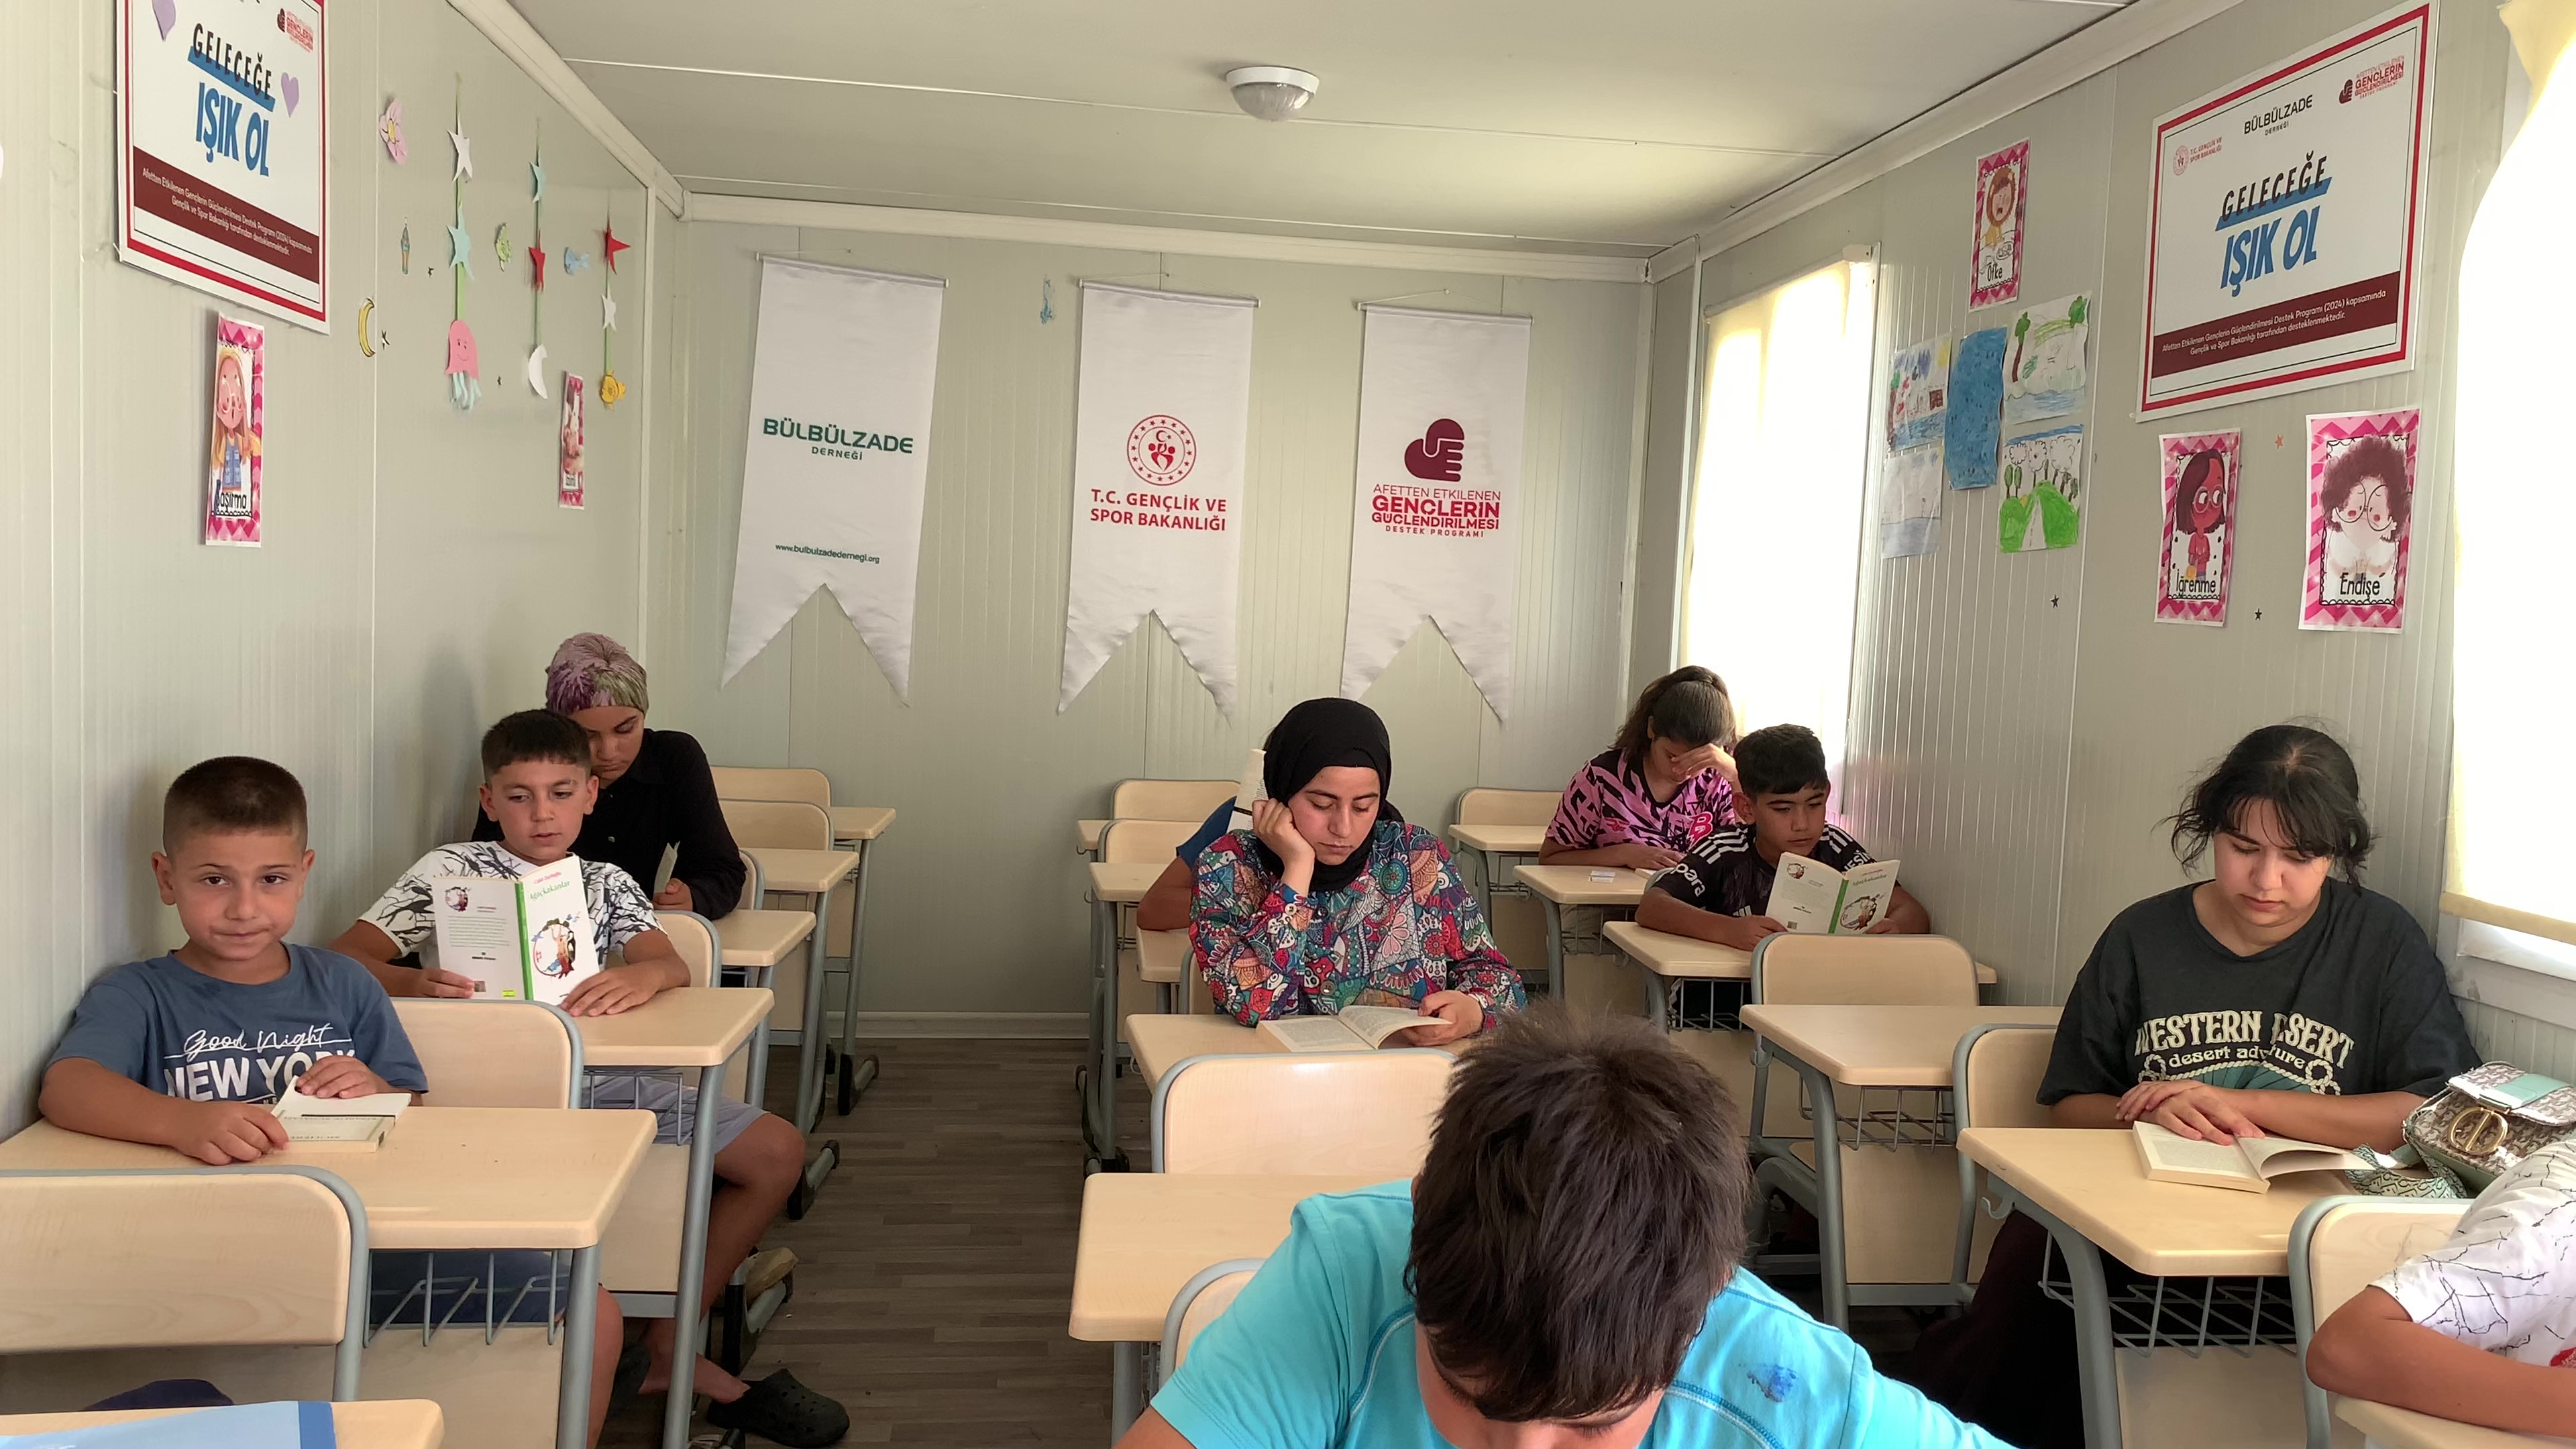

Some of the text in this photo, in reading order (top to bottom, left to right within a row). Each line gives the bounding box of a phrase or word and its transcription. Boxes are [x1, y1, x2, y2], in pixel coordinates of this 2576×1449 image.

[193, 22, 272, 100] GELECEĞE
[196, 82, 269, 176] IŞIK OL
[2244, 94, 2313, 135] BÜLBÜLZADE
[2222, 150, 2327, 222] GELECEĞE
[2220, 205, 2320, 297] IŞIK OL
[2162, 342, 2181, 353] Afetten
[2182, 335, 2205, 347] Etkilenen
[2274, 312, 2294, 324] Destek
[2296, 305, 2323, 319] Programı
[2324, 299, 2345, 313] (2024)
[2346, 290, 2386, 307] kapsamında
[2190, 343, 2210, 356] Gençlik
[2218, 339, 2230, 350] Spor
[2231, 333, 2256, 345] Bakanlığı
[763, 417, 914, 454] BÜLBÜLZADE
[812, 446, 863, 461] DERNEĞİ
[1091, 489, 1227, 513] T.C. GENÇLİK VE
[1373, 484, 1430, 497] AFETTEN
[1090, 508, 1226, 531] SPOR BAKANLIĞI
[1385, 525, 1484, 537] DESTEK PROGRAMI
[2339, 572, 2380, 600] Endişe
[184, 1023, 333, 1062] Good Night
[2134, 1009, 2263, 1057] WESTERN
[164, 1050, 355, 1102] NEW YO
[2168, 1045, 2231, 1069] desert
